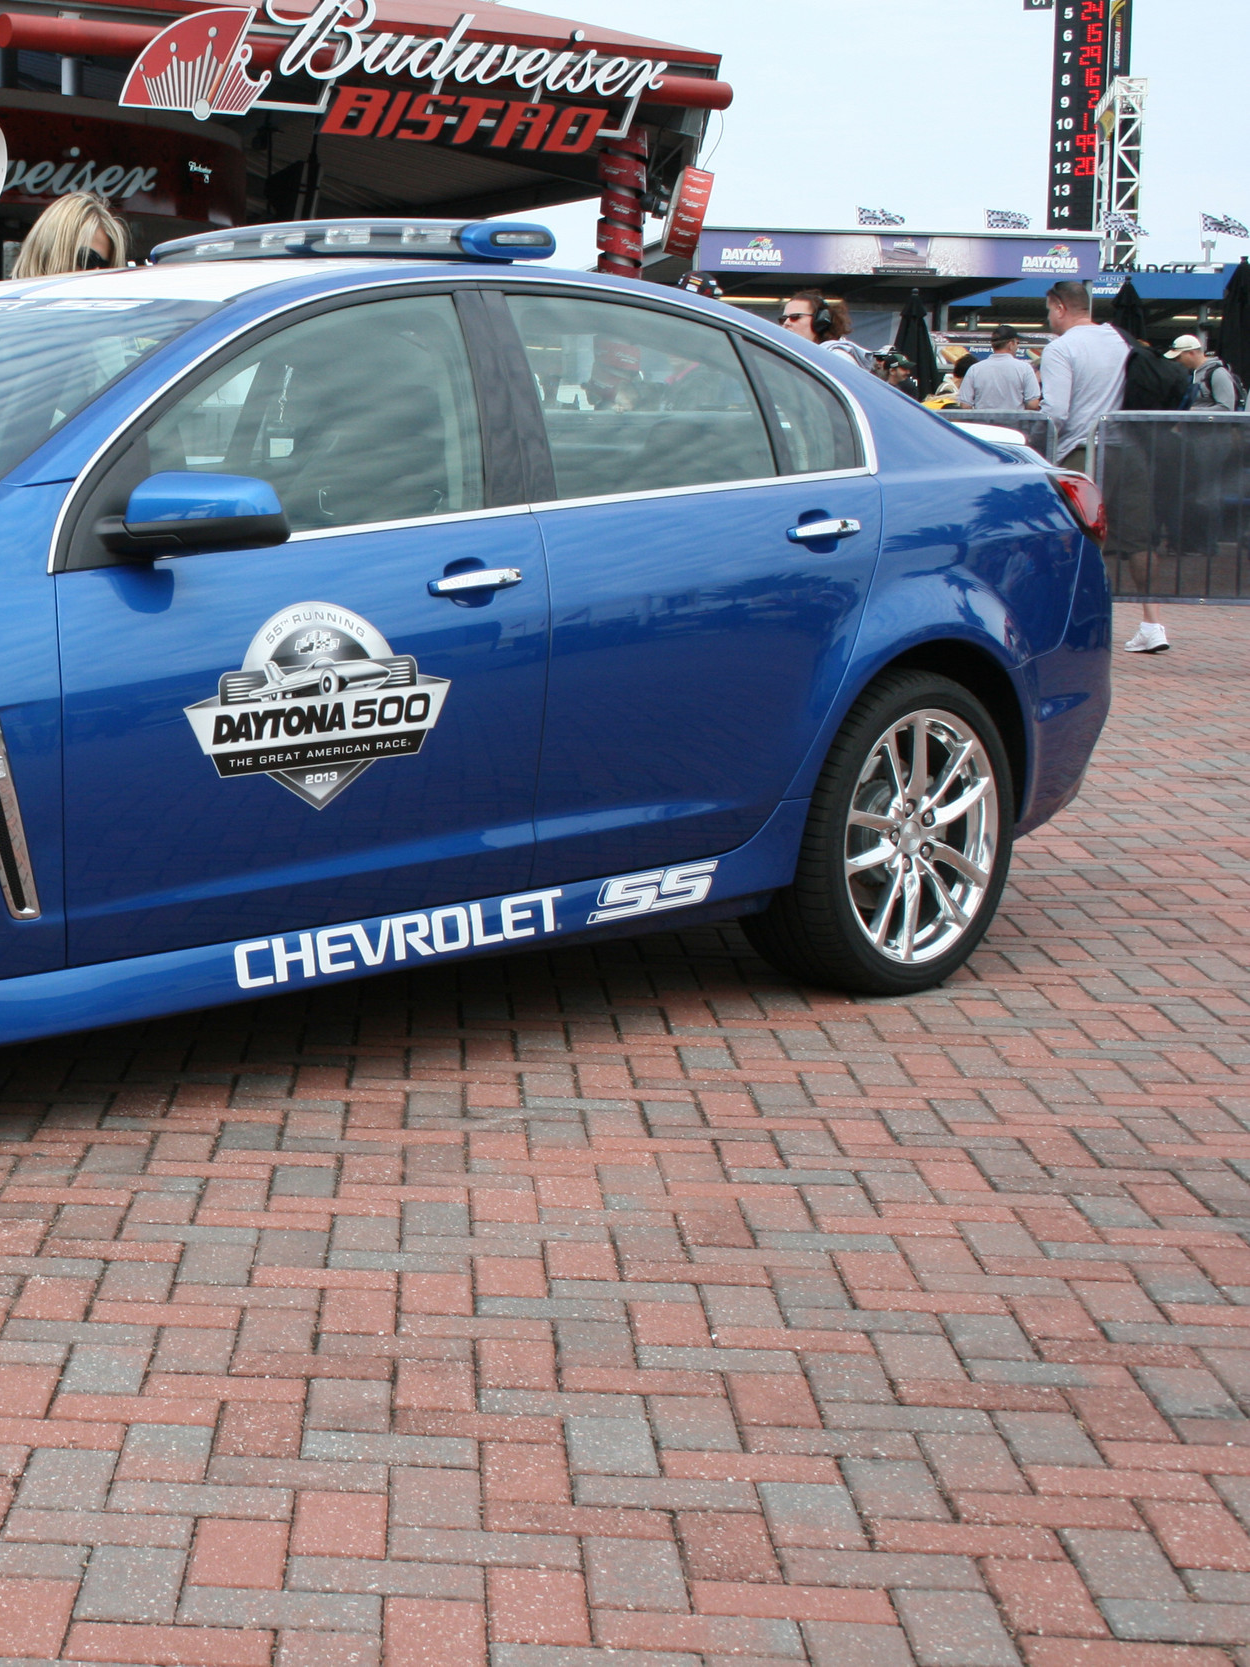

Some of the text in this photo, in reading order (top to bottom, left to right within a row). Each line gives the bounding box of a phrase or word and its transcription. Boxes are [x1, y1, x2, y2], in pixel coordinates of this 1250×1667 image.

[1063, 0, 1104, 20] 5 24
[1062, 30, 1073, 42] 6
[265, 0, 668, 98] Budweiser
[1062, 45, 1102, 65] 7 29
[1113, 31, 1121, 67] NASCAR
[1061, 73, 1071, 86] 8
[1060, 89, 1100, 109] 9 2
[318, 85, 608, 153] BISTRO
[1056, 117, 1074, 130] 10
[1054, 140, 1071, 152] 11
[1054, 161, 1071, 174] 12
[1053, 184, 1070, 196] 13
[1052, 206, 1070, 218] 14
[721, 248, 784, 262] DAYTONA
[1021, 255, 1080, 269] DAYTONA
[292, 611, 366, 639] RUNNING
[212, 692, 432, 746] DAYTONA 500
[228, 757, 253, 768] THE
[259, 750, 301, 764] GREAT
[306, 743, 371, 758] AMERICAN
[304, 771, 338, 785] 2013
[233, 860, 719, 990] CHEVROLET SS
